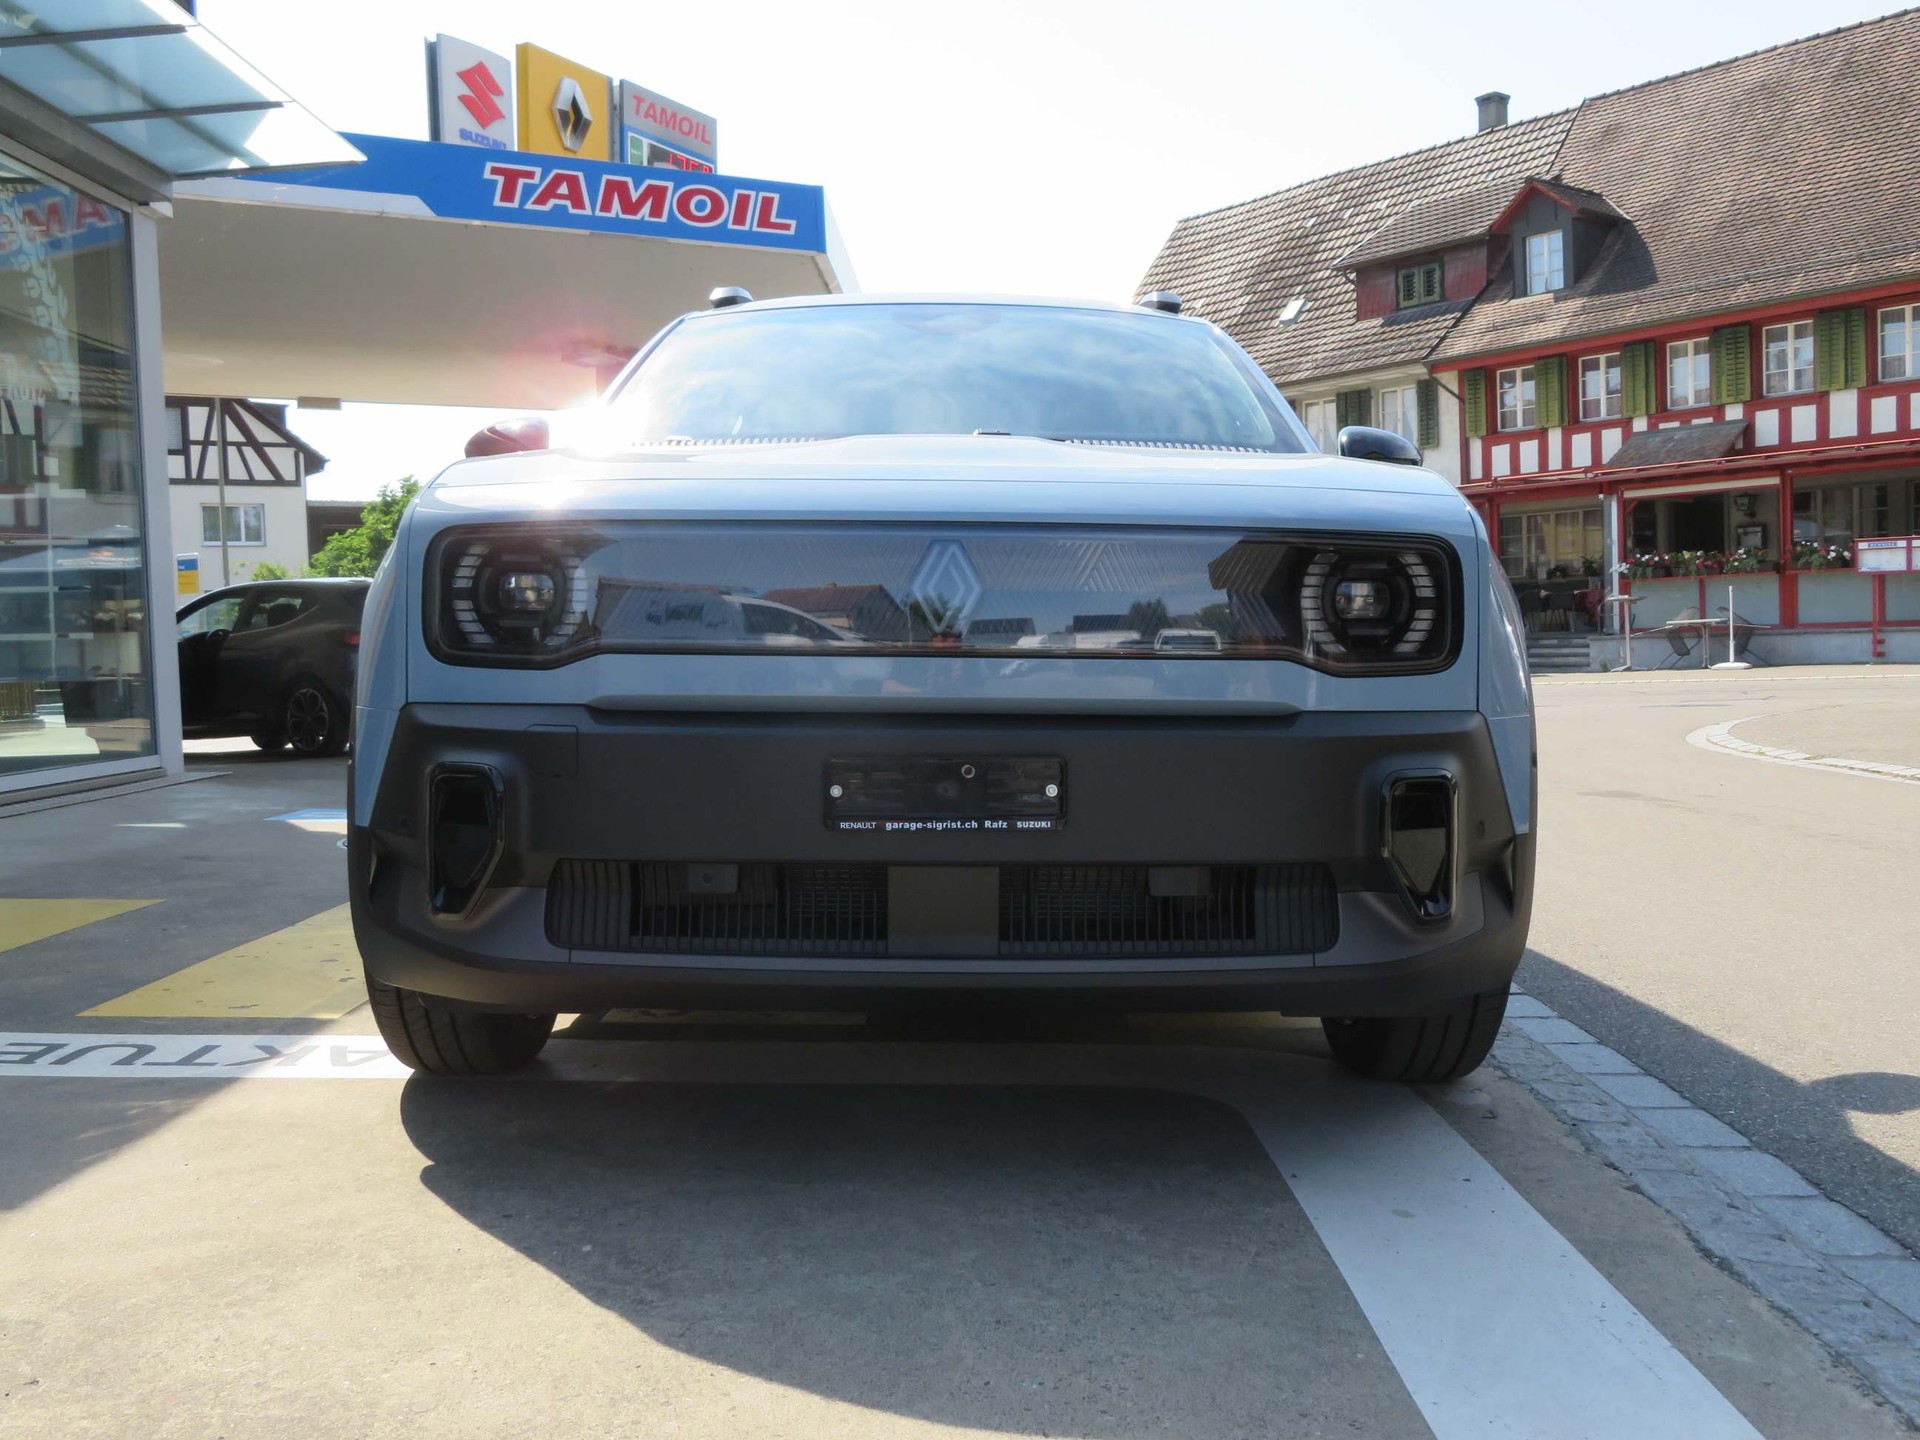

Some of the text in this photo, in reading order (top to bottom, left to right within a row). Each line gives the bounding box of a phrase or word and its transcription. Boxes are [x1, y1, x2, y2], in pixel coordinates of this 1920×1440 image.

[632, 95, 712, 145] TAMOIL
[485, 163, 796, 234] TAMOIL
[840, 820, 1051, 831] RENAULT garage-sigrist.ch Rafz SUZUKI
